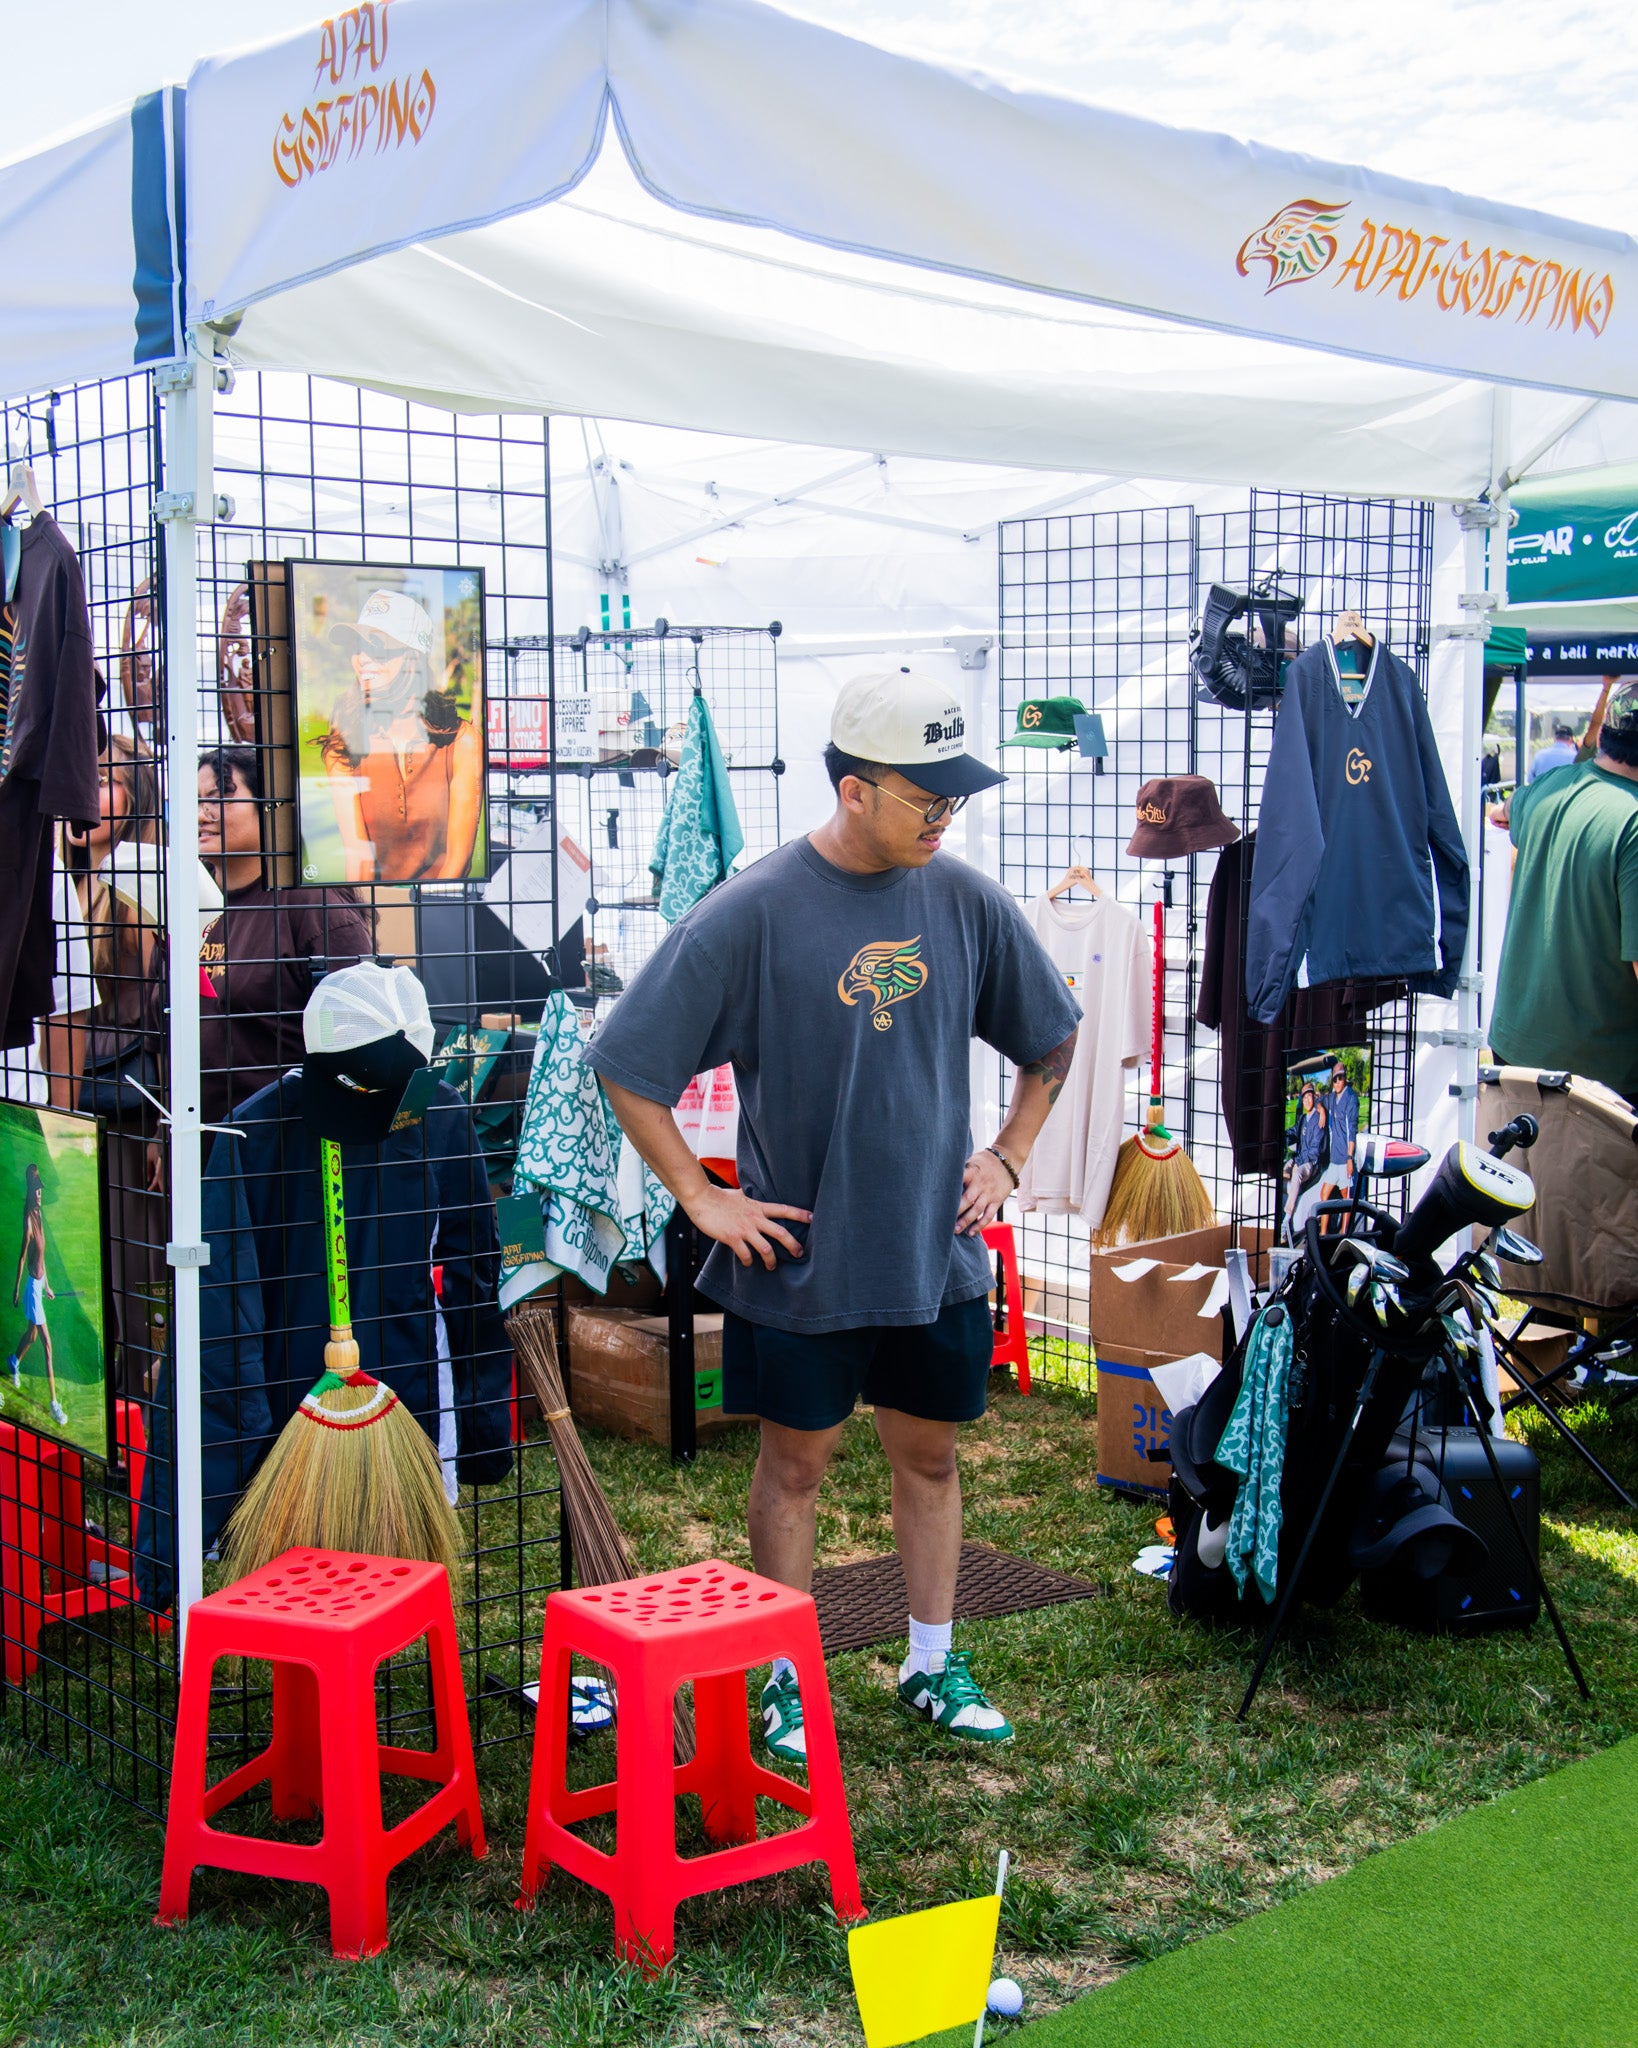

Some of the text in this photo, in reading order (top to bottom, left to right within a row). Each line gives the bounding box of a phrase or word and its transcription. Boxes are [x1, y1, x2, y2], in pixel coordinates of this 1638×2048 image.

[273, 68, 436, 188] GOLFIPINO
[1521, 555, 1548, 565] CLUB
[1542, 647, 1551, 659] a
[1560, 645, 1586, 660] ball
[503, 1243, 522, 1256] APAT
